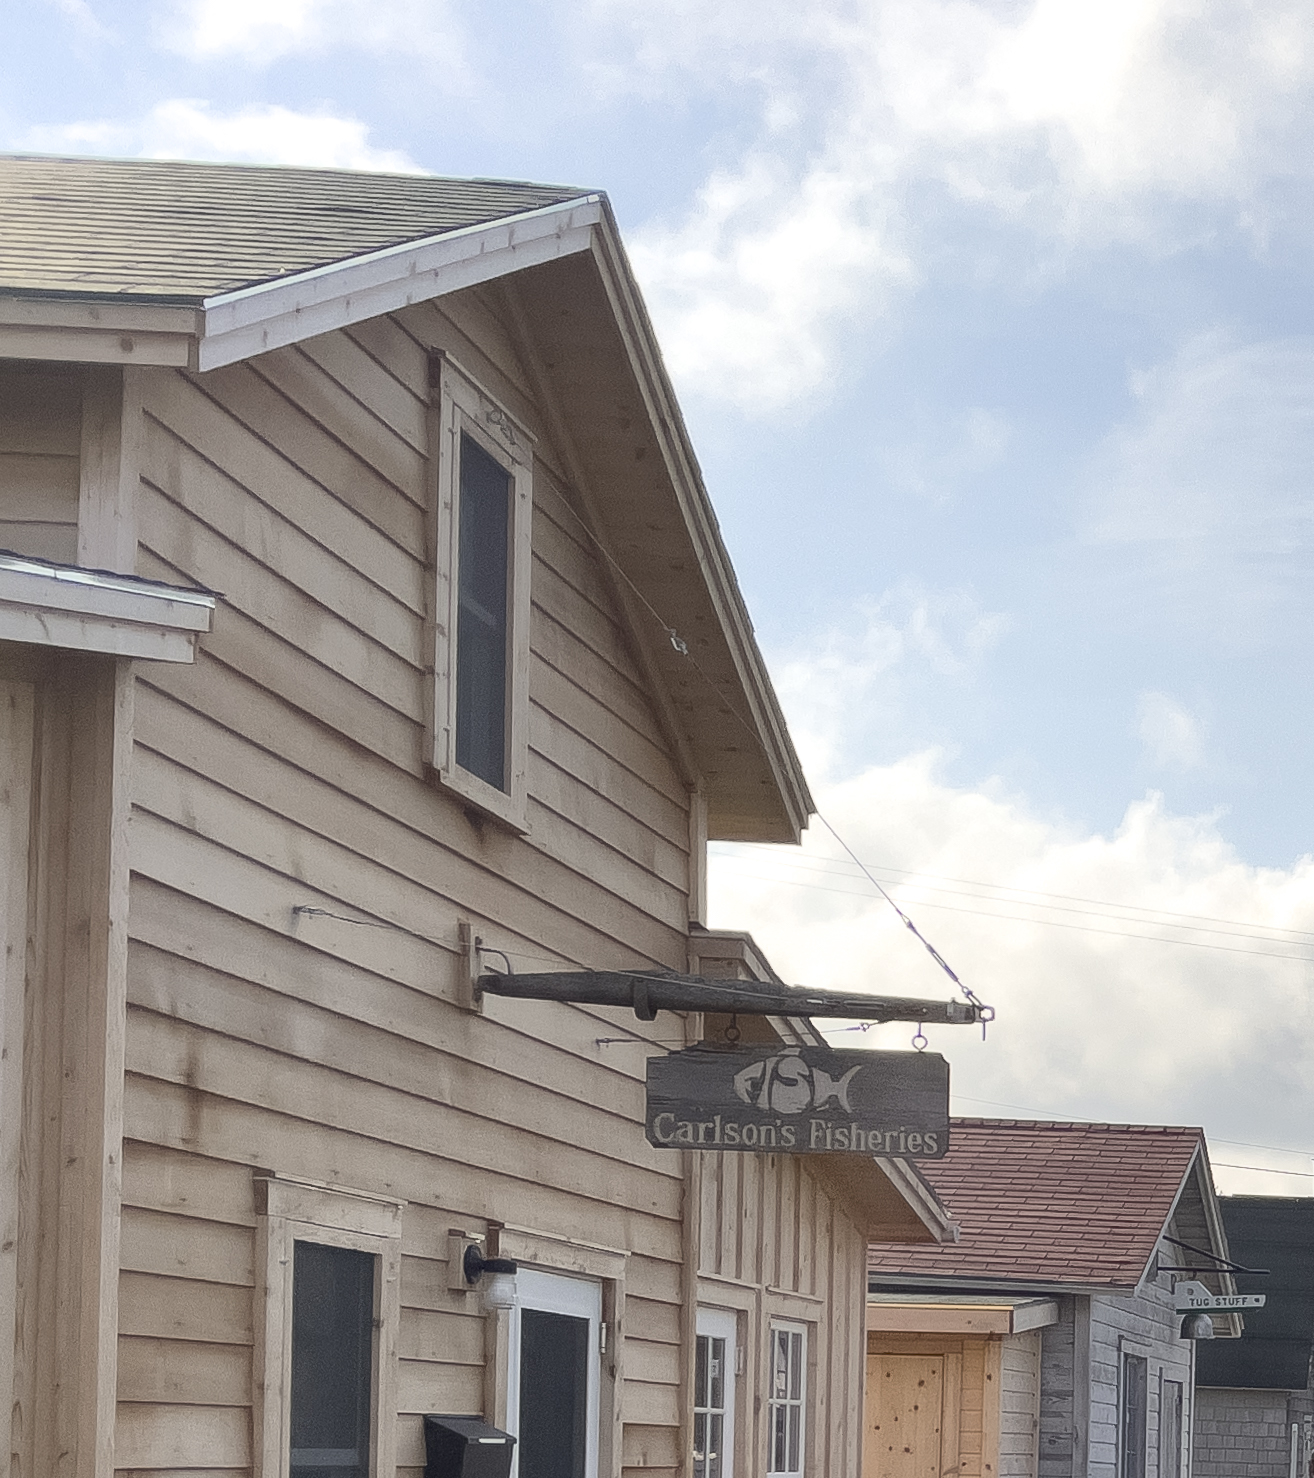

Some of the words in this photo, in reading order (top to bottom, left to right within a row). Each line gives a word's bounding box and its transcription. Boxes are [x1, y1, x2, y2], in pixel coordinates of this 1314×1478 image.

[653, 1112, 796, 1147] Carlson's
[809, 1118, 938, 1154] Fisheries
[1189, 1297, 1210, 1307] TUG
[1214, 1296, 1248, 1306] STUFF
